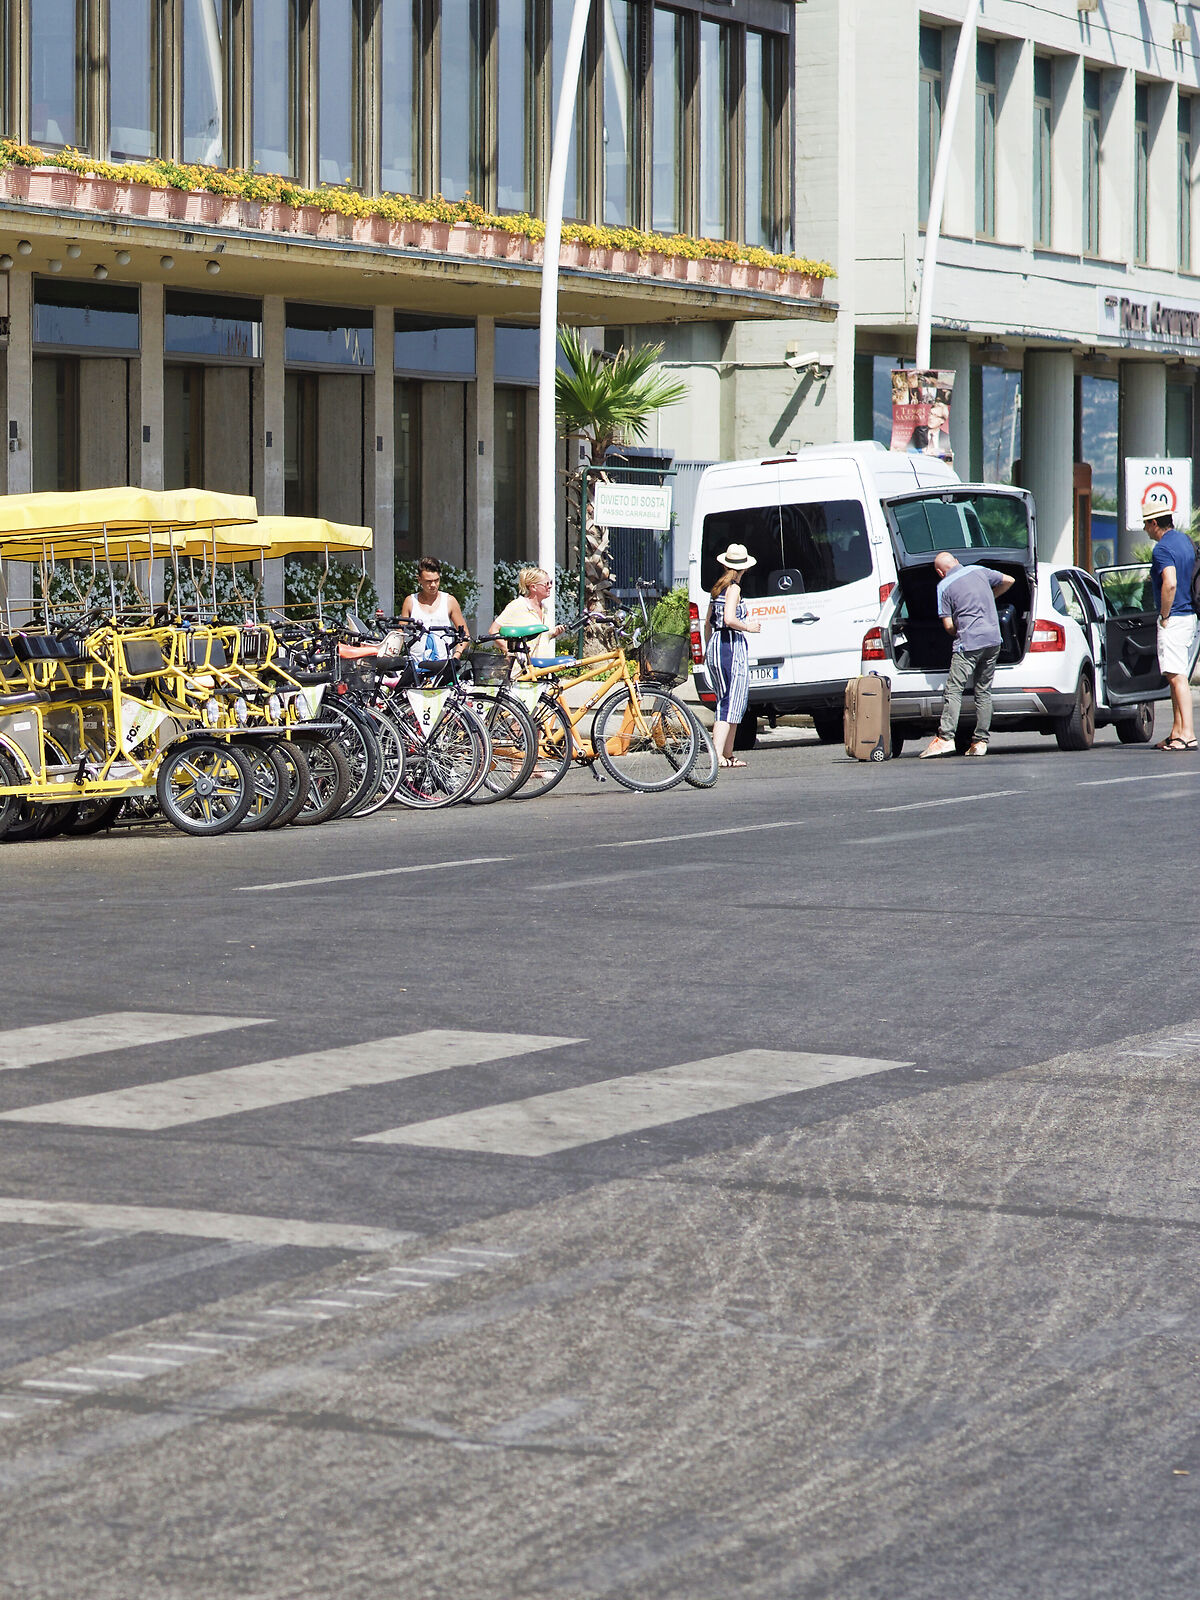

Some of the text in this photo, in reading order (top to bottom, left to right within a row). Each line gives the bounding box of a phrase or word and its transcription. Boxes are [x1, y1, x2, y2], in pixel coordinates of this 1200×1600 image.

[1144, 466, 1173, 476] zona
[600, 494, 666, 508] DIVIETO DI SOSTA
[751, 605, 786, 617] PENNA
[422, 706, 431, 726] FOX
[126, 723, 141, 743] FOX
